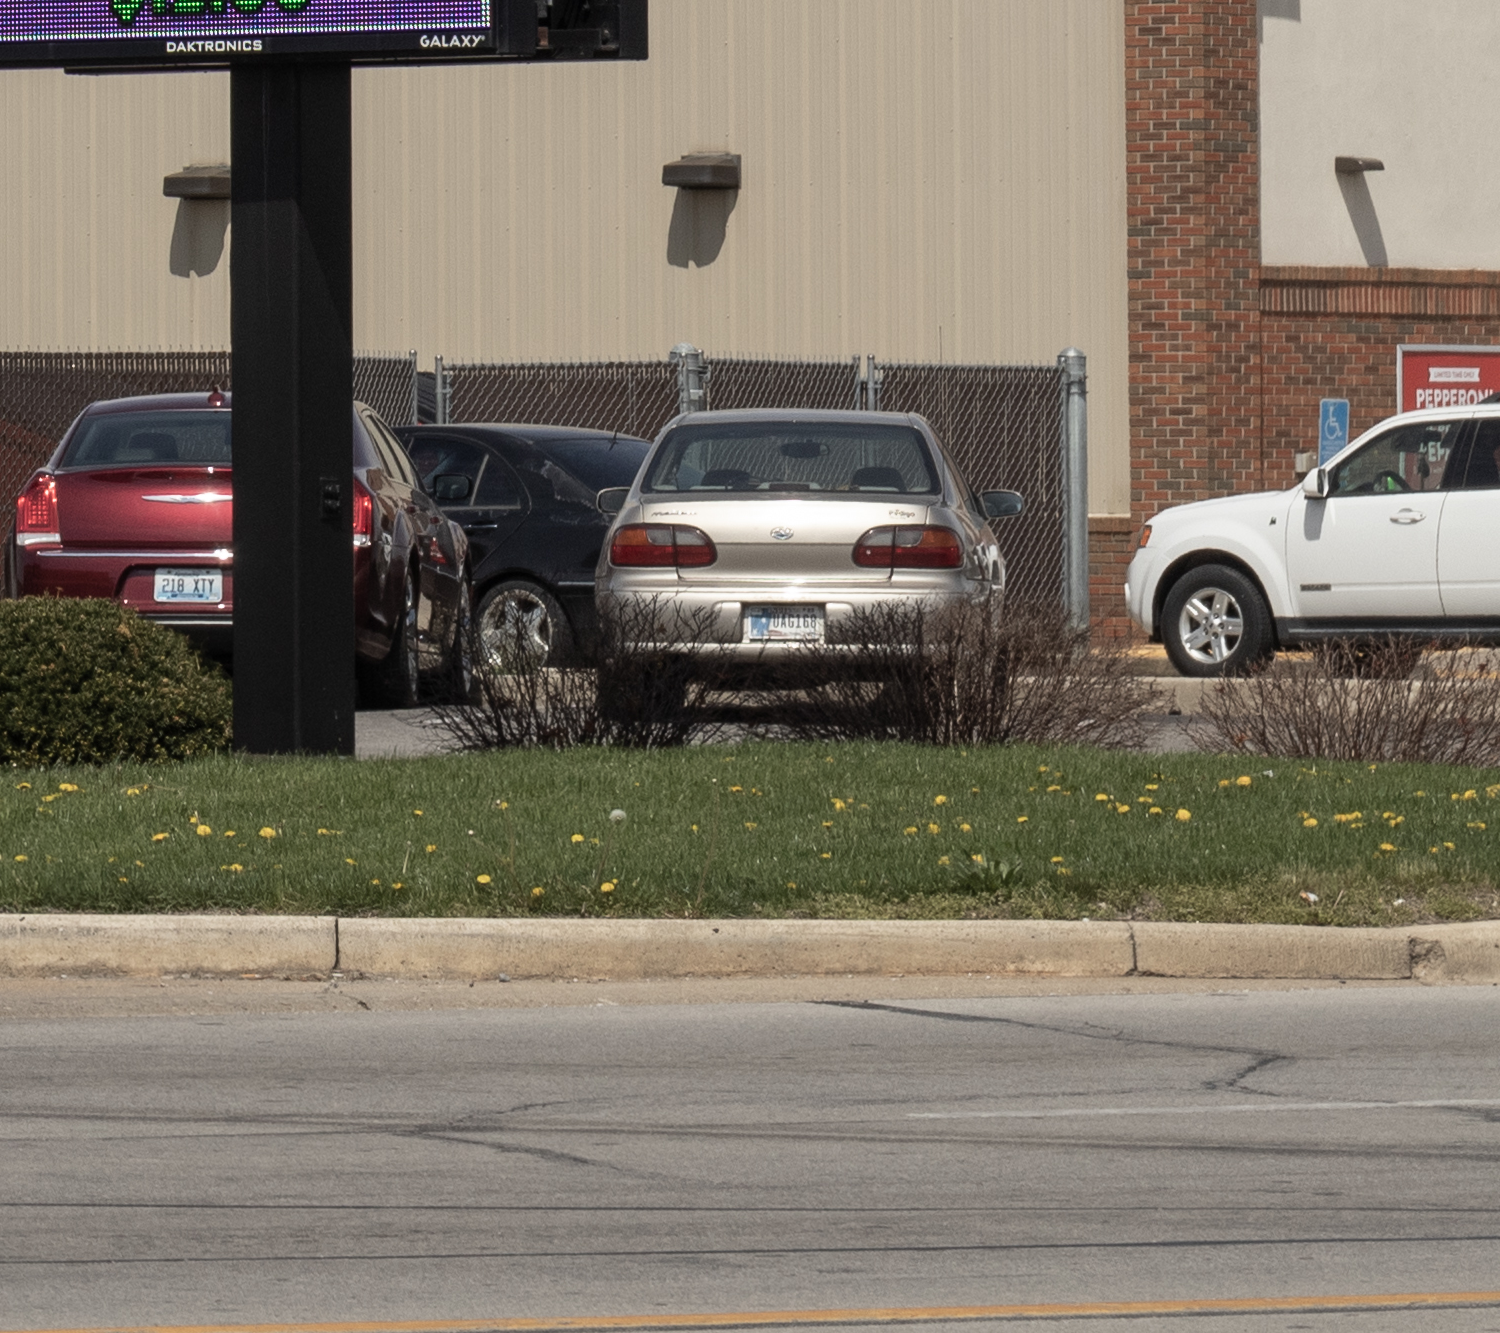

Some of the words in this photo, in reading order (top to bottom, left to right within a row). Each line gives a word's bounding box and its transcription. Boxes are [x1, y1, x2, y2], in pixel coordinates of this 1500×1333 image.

[167, 39, 263, 53] DAKTRONICS
[420, 35, 481, 49] GALAXY
[162, 578, 185, 593] 218
[193, 578, 215, 593] XTY
